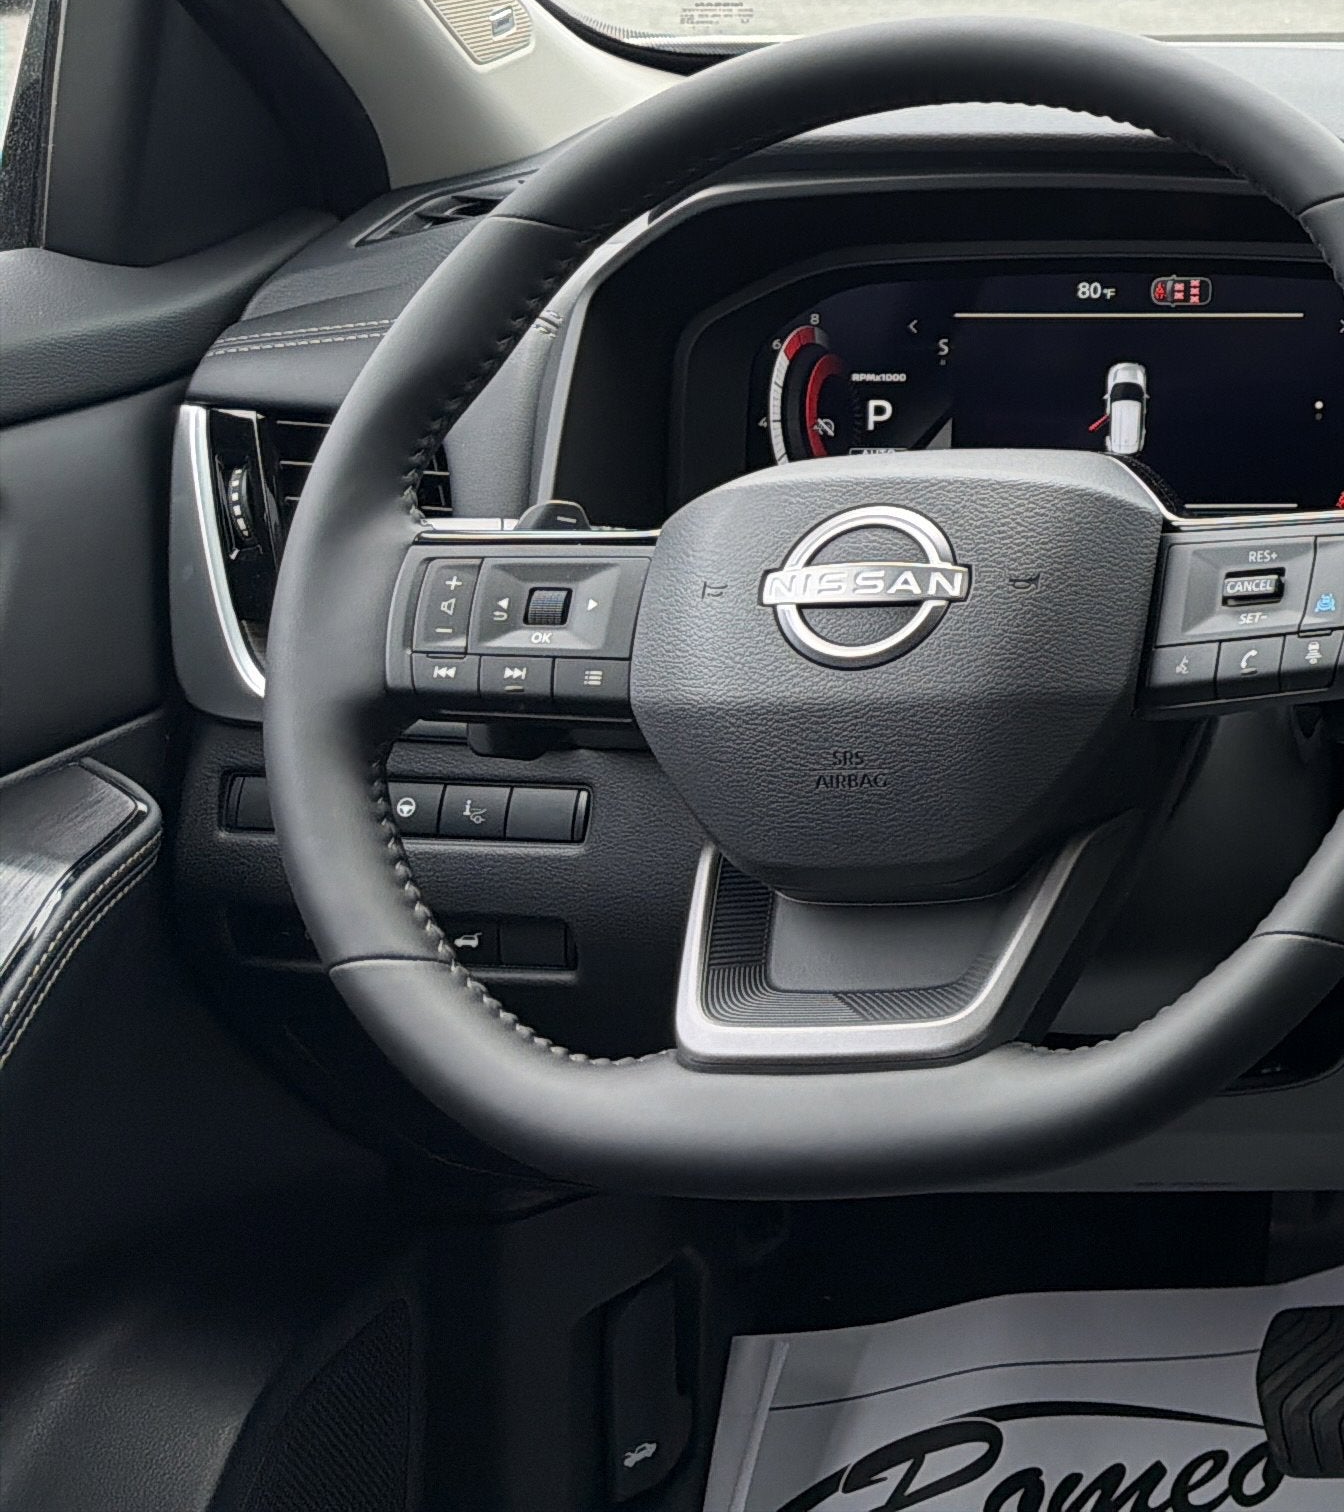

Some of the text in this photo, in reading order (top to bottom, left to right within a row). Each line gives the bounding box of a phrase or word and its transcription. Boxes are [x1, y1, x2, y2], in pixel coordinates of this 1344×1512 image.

[810, 314, 819, 324] 8
[772, 339, 781, 350] 6
[938, 339, 949, 355] S
[867, 399, 892, 430] P
[758, 417, 768, 428] 4
[1249, 550, 1278, 562] RES+
[764, 568, 963, 598] NISSAN
[1226, 579, 1273, 593] CANCEL
[531, 632, 552, 644] OK
[832, 749, 864, 766] SRS
[815, 773, 887, 789] AIRBAG
